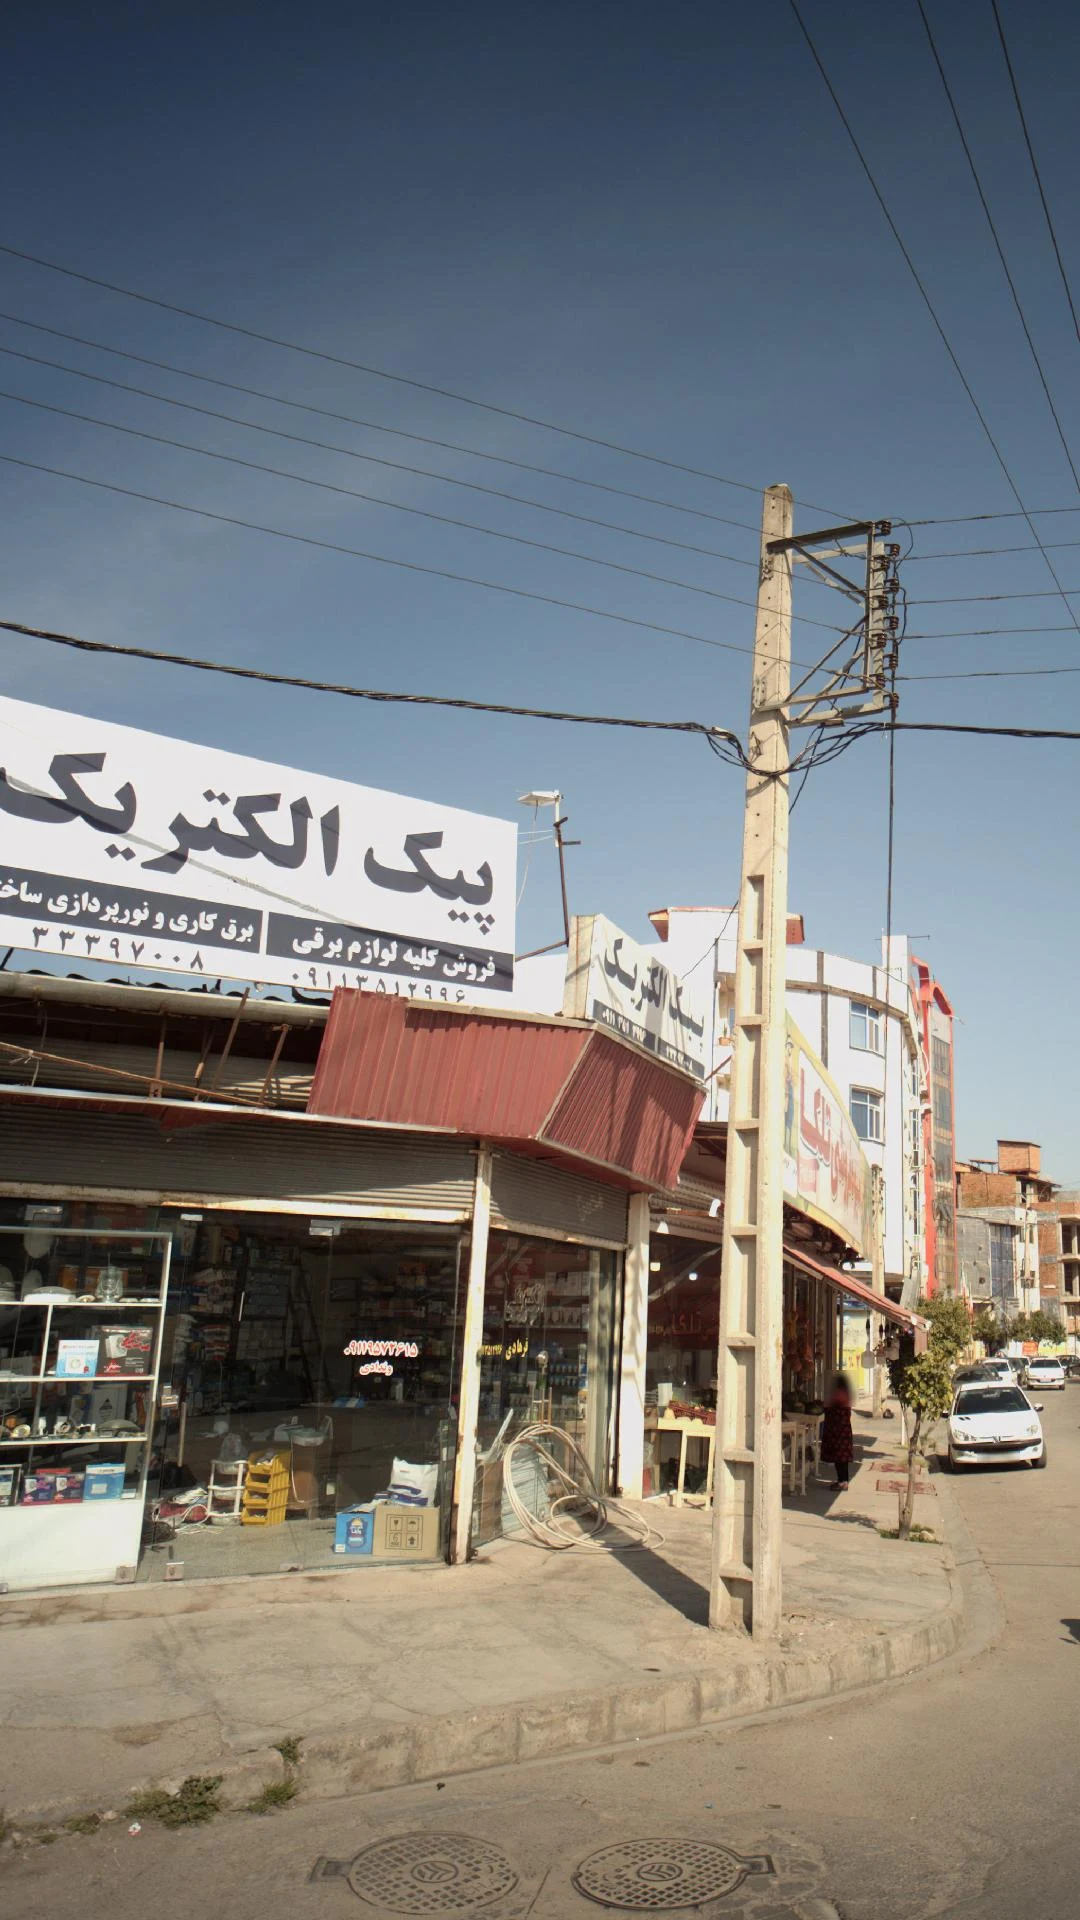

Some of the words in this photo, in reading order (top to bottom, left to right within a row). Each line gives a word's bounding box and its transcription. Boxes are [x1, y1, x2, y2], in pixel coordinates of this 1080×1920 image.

[0, 752, 340, 875] الکتریک
[0, 878, 43, 904] ساخ
[364, 831, 495, 935] پیک
[46, 891, 150, 926] نورپردازی
[152, 912, 164, 930] و
[168, 911, 218, 936] کاری
[220, 919, 254, 943] برق
[32, 926, 204, 971] ۳۳۳۹۷۰۰۸
[292, 926, 343, 959] برقی
[347, 938, 398, 966] لوازم
[402, 946, 439, 971] کلیه
[442, 952, 496, 982] فروش
